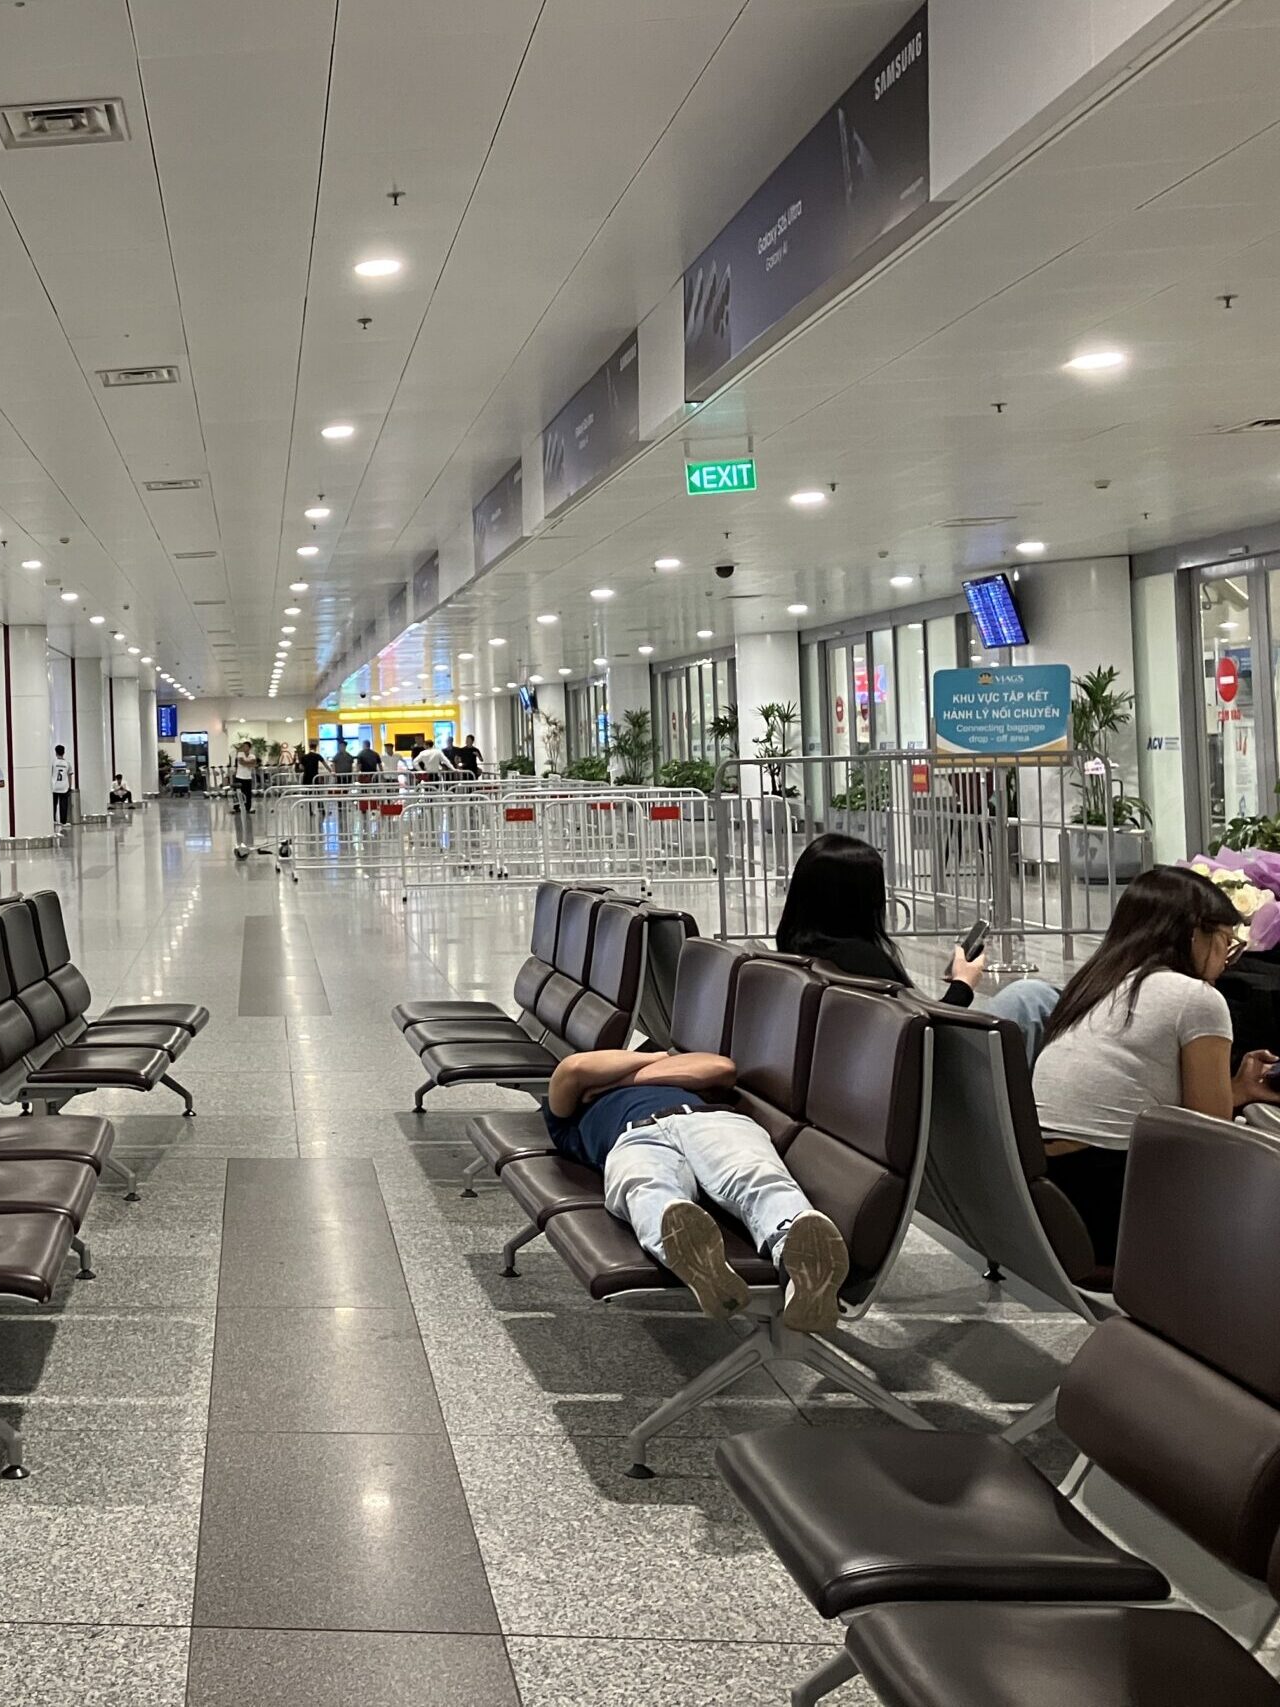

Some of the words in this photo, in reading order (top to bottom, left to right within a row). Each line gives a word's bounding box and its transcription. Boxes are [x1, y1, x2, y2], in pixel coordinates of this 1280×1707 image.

[874, 31, 922, 101] SAMSUNG
[758, 224, 777, 254] Galaxy
[702, 463, 752, 489] EXIT
[952, 694, 975, 704] KHU
[977, 691, 1000, 705] VỰC
[1003, 690, 1024, 705] TẬP
[1027, 688, 1049, 701] KẾT
[943, 707, 973, 720] HÀNH
[975, 707, 989, 720] LÝ
[956, 724, 1004, 733] Connecting
[1007, 723, 1045, 733] baggage
[968, 735, 988, 744] drop
[996, 734, 1008, 742] off
[1010, 735, 1030, 743] area
[1146, 736, 1163, 751] ACV
